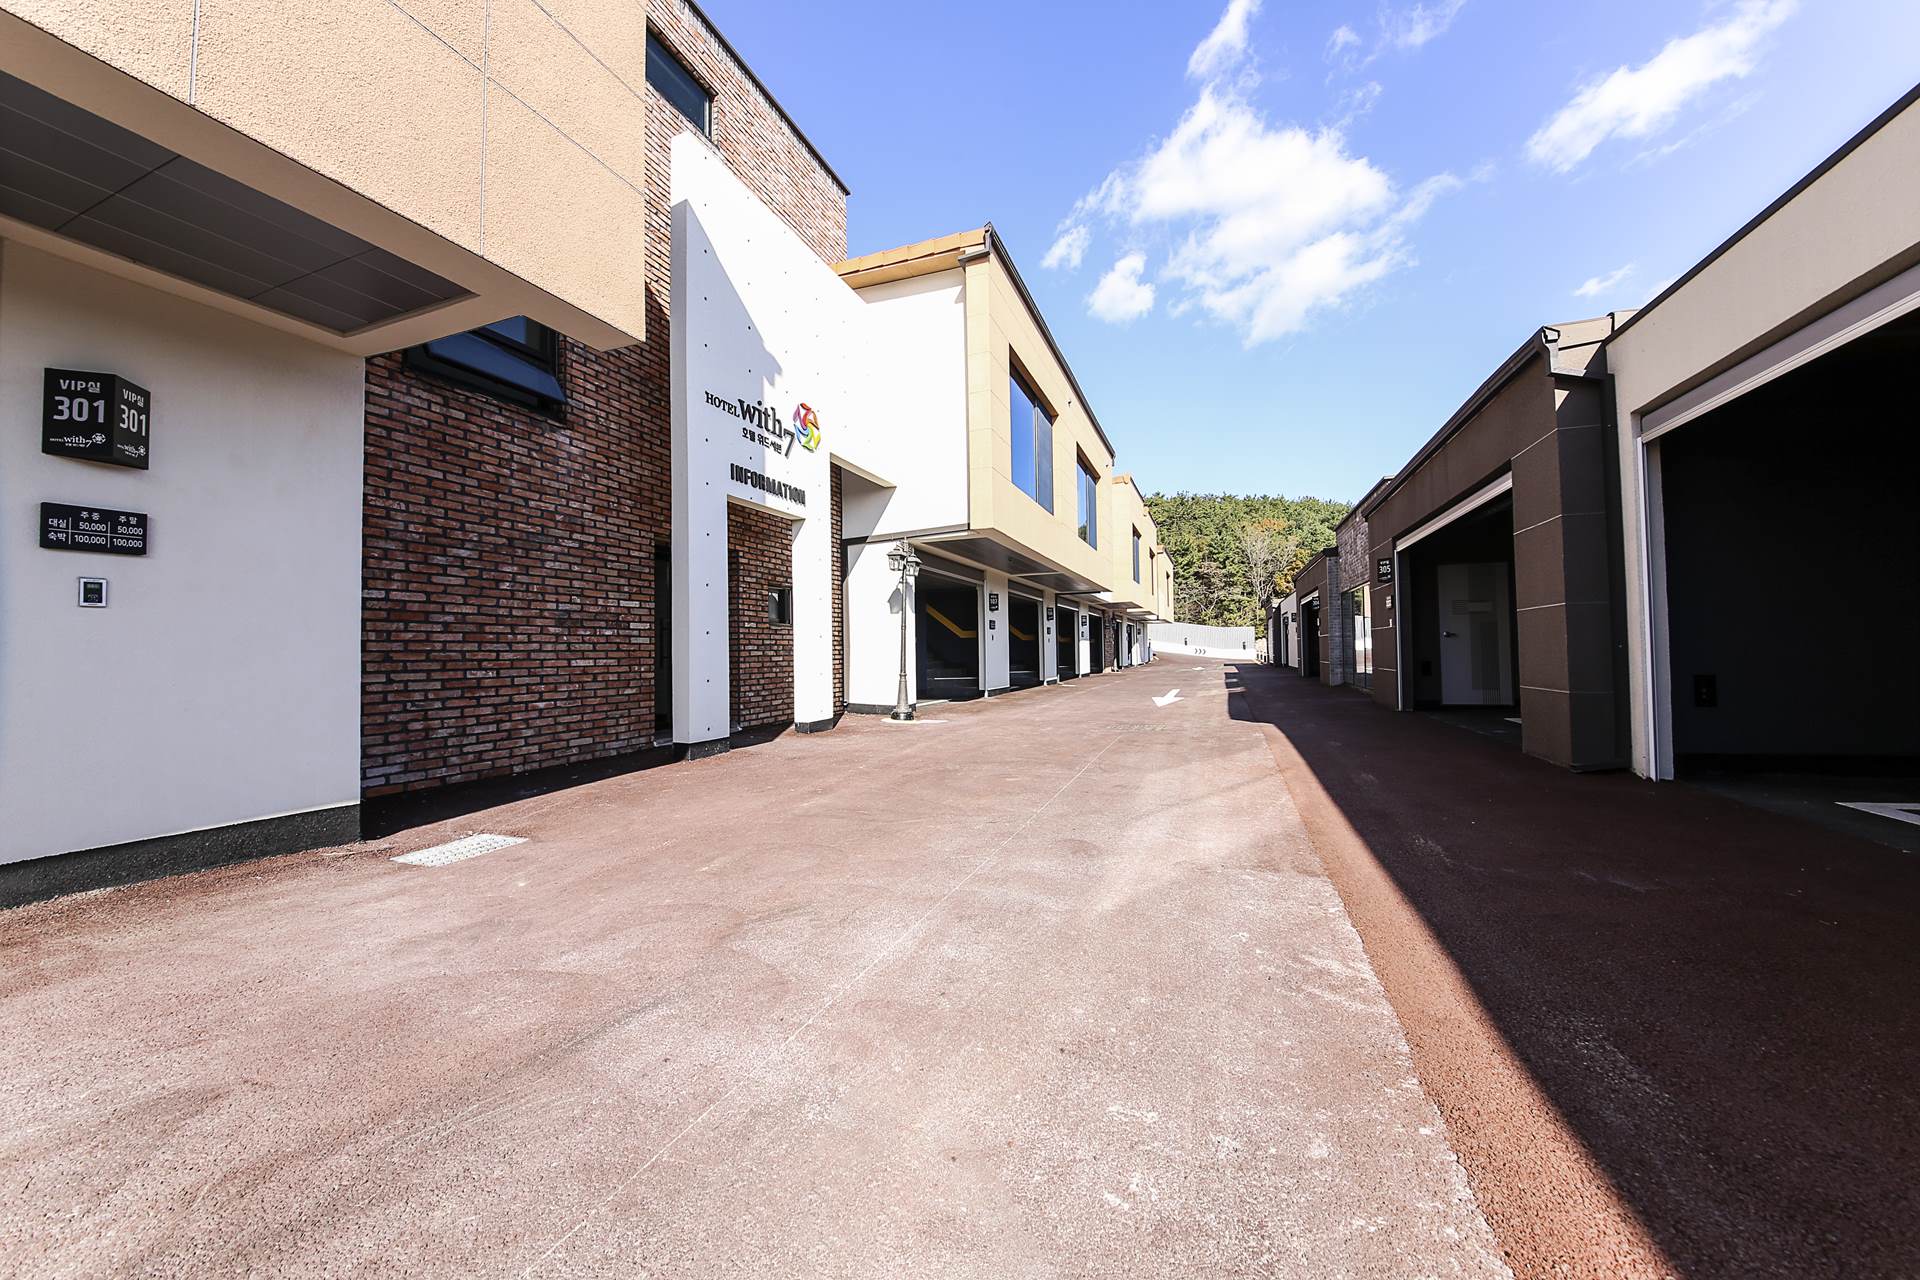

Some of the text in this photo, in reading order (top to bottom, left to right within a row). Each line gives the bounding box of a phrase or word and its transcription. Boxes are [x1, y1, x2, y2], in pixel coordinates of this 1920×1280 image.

[53, 395, 105, 423] 301
[705, 390, 740, 418] HOTEL
[119, 404, 146, 436] 301
[730, 463, 806, 507] INFORMATION
[74, 534, 106, 545] 100,000
[113, 538, 143, 548] 100,000
[79, 522, 106, 532] 50,000
[117, 526, 143, 535] 50,000
[1379, 564, 1391, 574] 305
